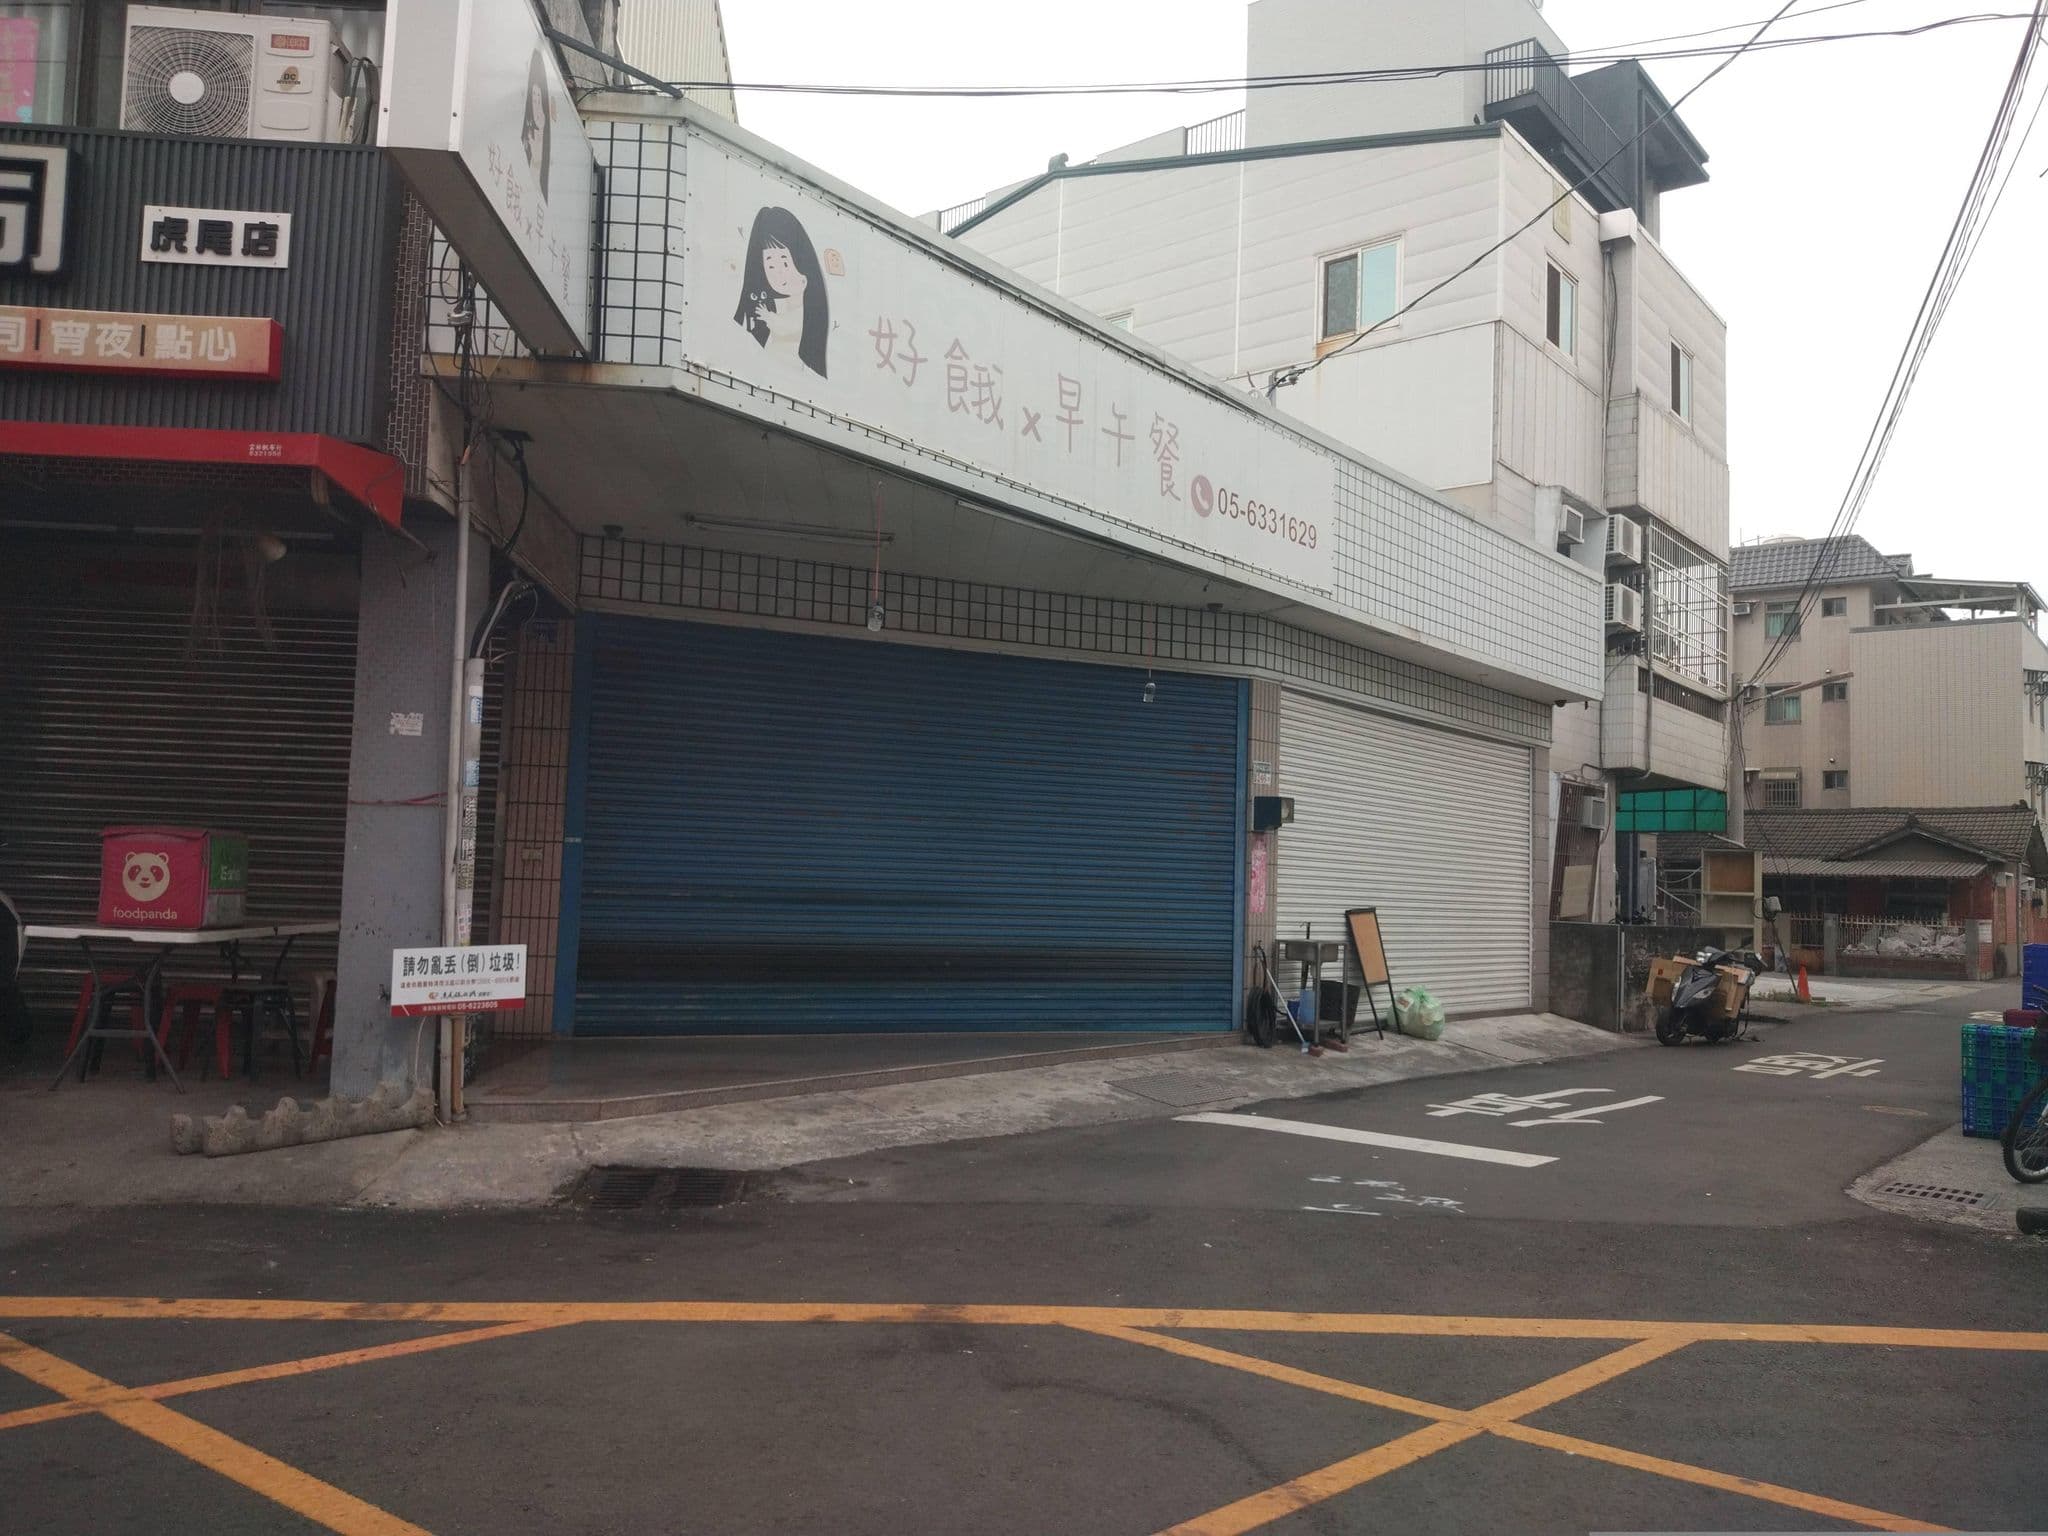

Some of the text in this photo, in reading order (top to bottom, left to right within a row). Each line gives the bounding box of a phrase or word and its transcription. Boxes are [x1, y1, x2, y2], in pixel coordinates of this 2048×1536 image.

[283, 73, 297, 81] DC
[151, 216, 279, 257] 虎尾店
[51, 320, 134, 359] 宵夜
[155, 324, 237, 361] 點心
[1217, 487, 1319, 550] 05-6331629
[113, 907, 178, 921] foodpanda
[1733, 1052, 1886, 1079] 慢
[1426, 1088, 1665, 1127] 停
